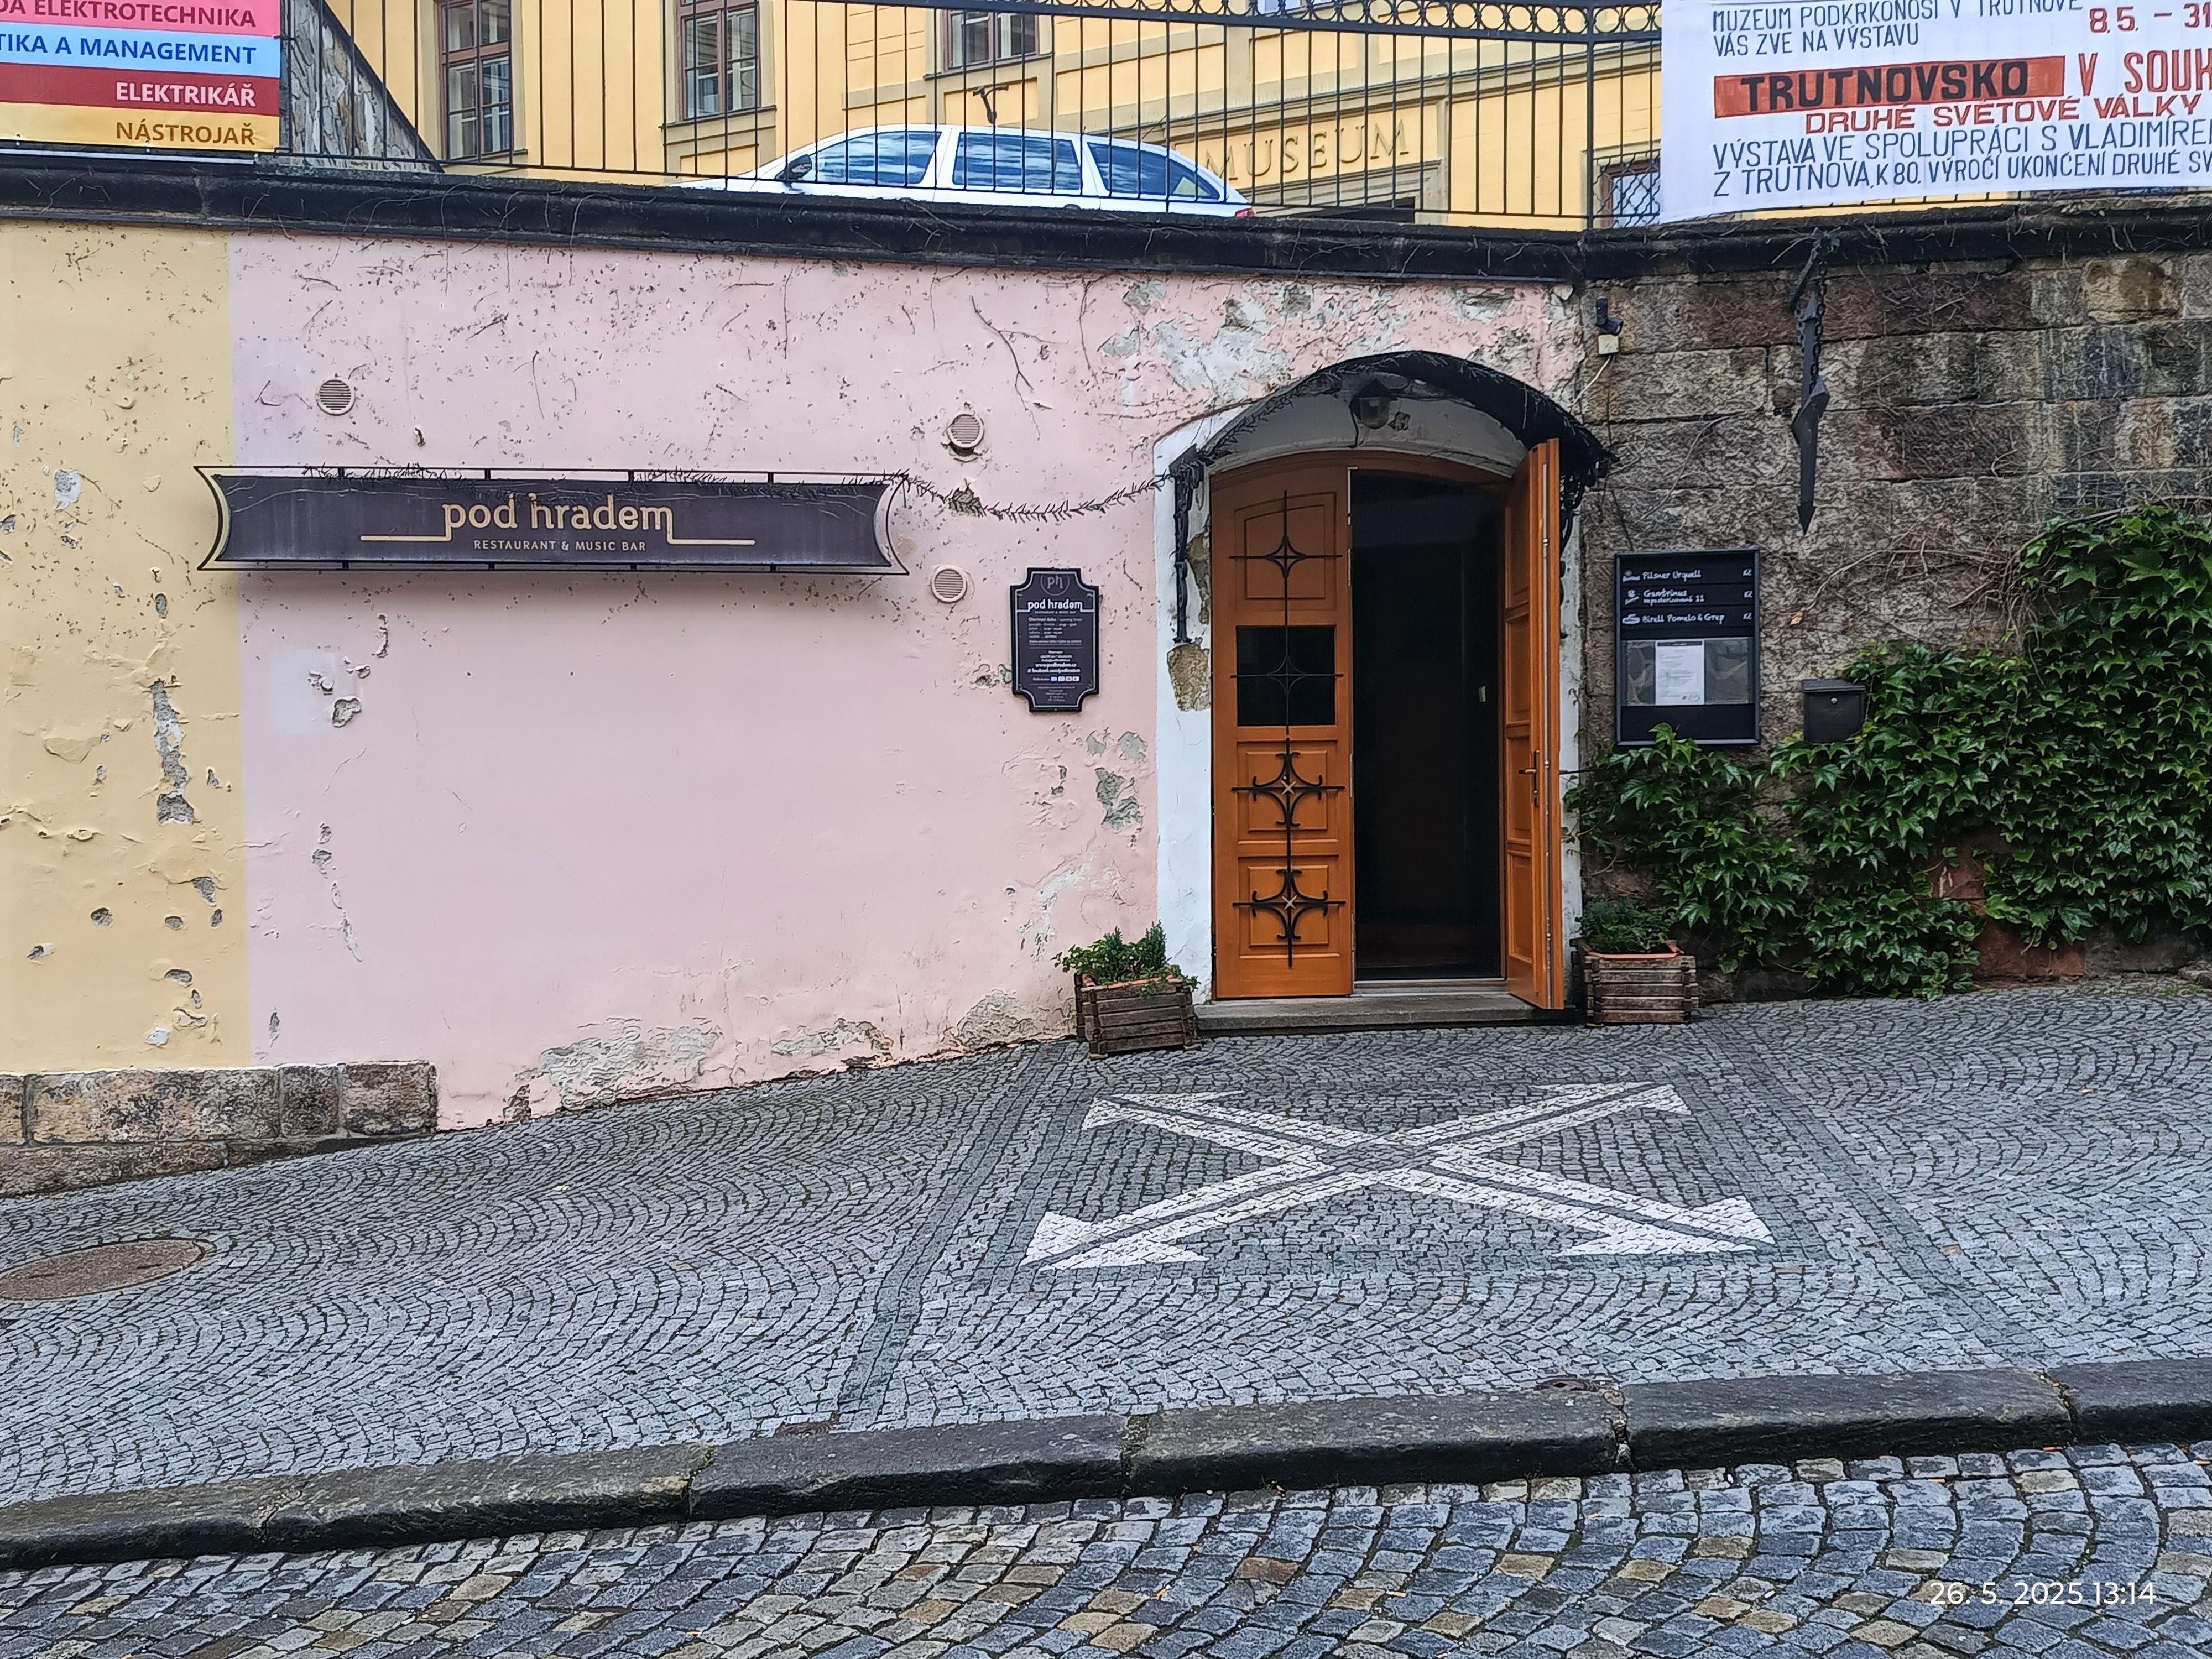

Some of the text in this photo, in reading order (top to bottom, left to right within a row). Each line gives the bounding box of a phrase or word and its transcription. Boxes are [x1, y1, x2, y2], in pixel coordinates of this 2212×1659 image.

[35, 0, 256, 27] ELEKTROTECHNIKA
[1713, 8, 1791, 32] MUZEUM
[1950, 0, 1961, 18] V
[55, 36, 72, 54] A
[81, 38, 257, 64] MANAGEMENT
[1714, 23, 1919, 56] VÁS ZVE NA VÝSTAVU
[116, 81, 256, 107] ELEKTRIKÁŘ
[1740, 61, 2028, 111] TRUTNOVSKO
[2078, 53, 2099, 96] V
[1806, 93, 2201, 134] DRUHÉ SVĚTOVÉ VÁLKY
[116, 118, 255, 145] NÁSTROJAŘ
[1713, 114, 2212, 170] VÝSTAVA VE SPOLUPRÁCI S VLADIMÍRE
[1204, 119, 1410, 181] MUSEUM
[1714, 171, 1731, 197] Z
[1876, 164, 1889, 186] K
[1893, 161, 1922, 185] 80.
[2112, 149, 2180, 176] DRUHÉ
[2189, 150, 2212, 173] SV
[442, 493, 672, 538] pod hradem
[474, 540, 646, 551] RESTAURANT & MUSIC BAR
[1642, 571, 1670, 580] Pilsner
[1672, 570, 1702, 582] Urquell
[1027, 598, 1082, 611] pod hradem
[1643, 588, 1687, 597] Gambrinus
[1642, 615, 1665, 623] Birell
[1667, 614, 1697, 623] Pomelo
